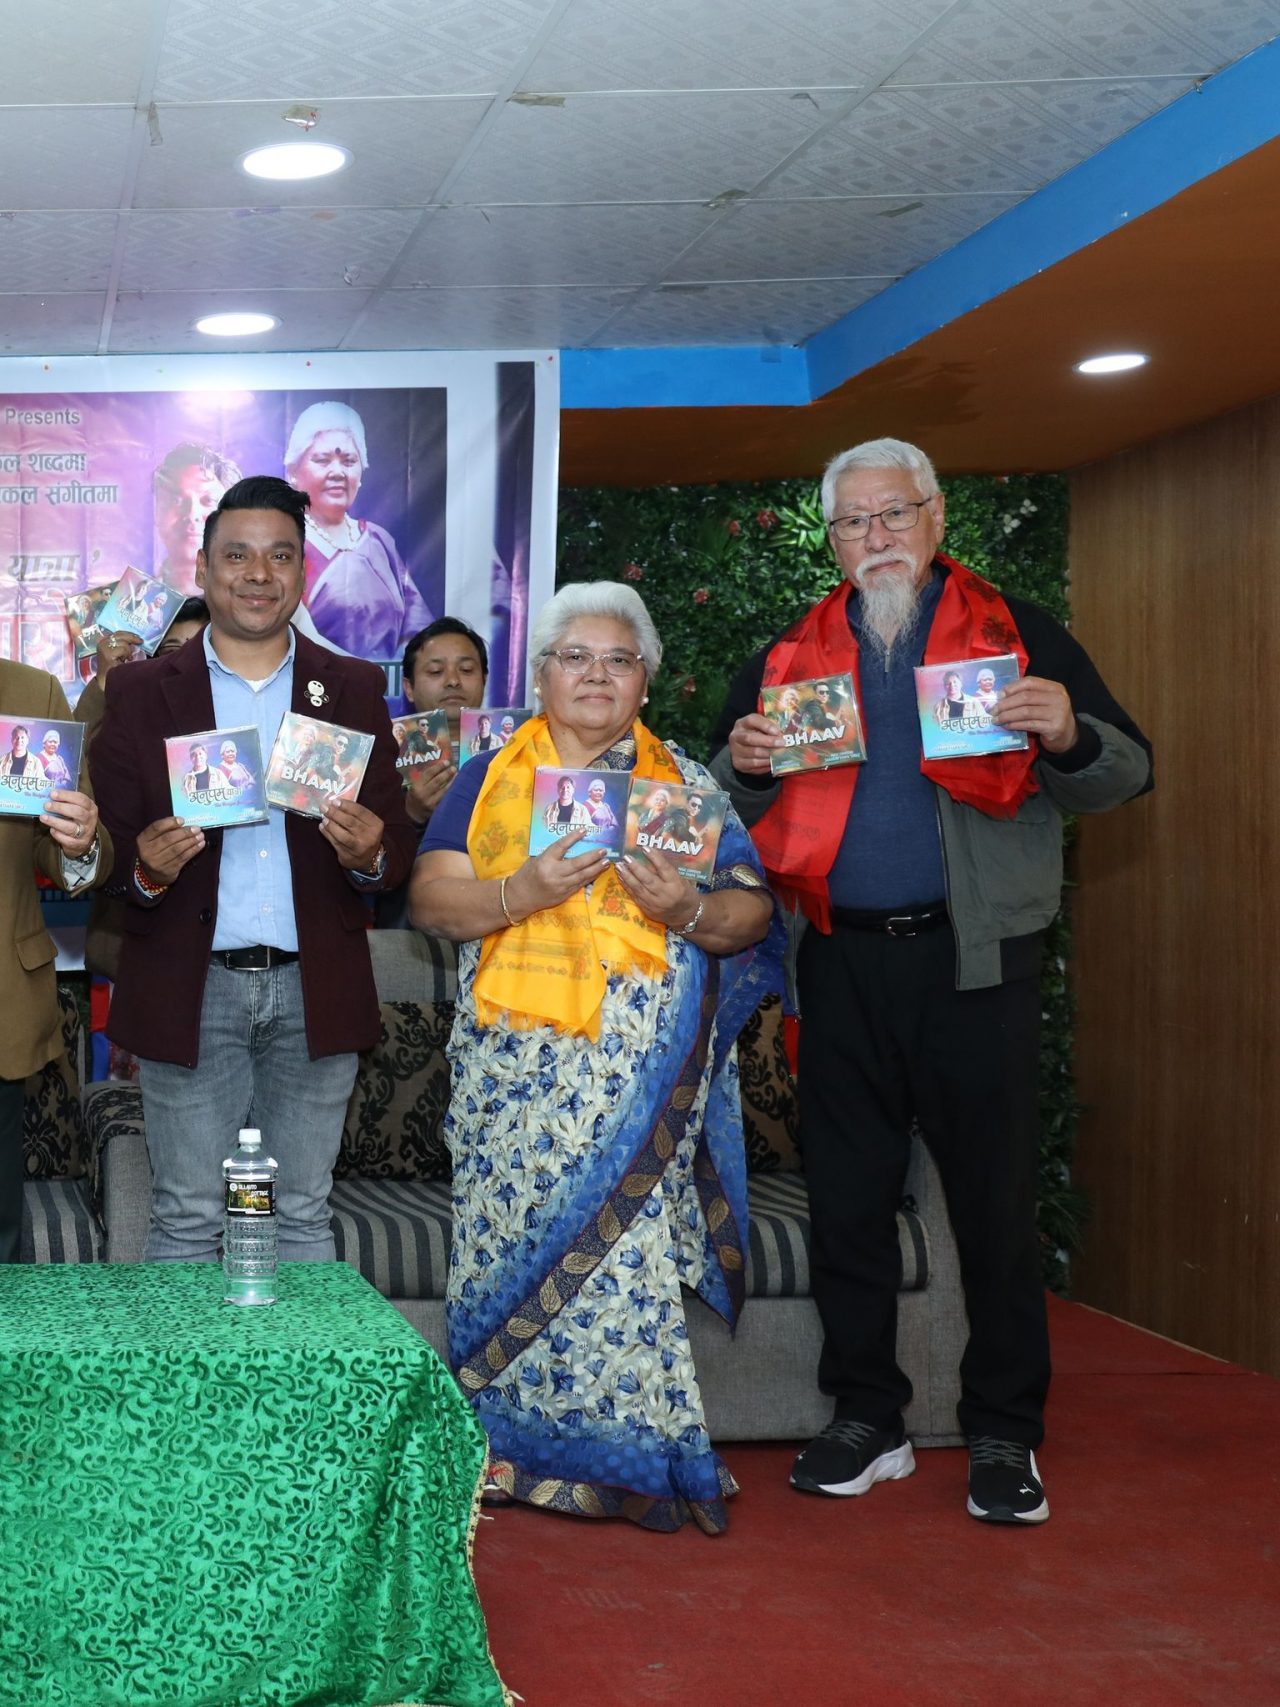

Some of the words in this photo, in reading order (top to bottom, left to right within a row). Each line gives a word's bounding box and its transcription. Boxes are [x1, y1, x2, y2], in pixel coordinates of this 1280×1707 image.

[5, 407, 80, 425] Presents
[28, 452, 87, 473] शब्दमा
[45, 481, 118, 506] संगीतमा
[783, 725, 845, 747] BHAAV
[395, 749, 442, 769] BHAAV
[1, 775, 40, 792] अनुपम
[281, 765, 346, 796] BHAAV
[636, 832, 704, 856] BHAAV
